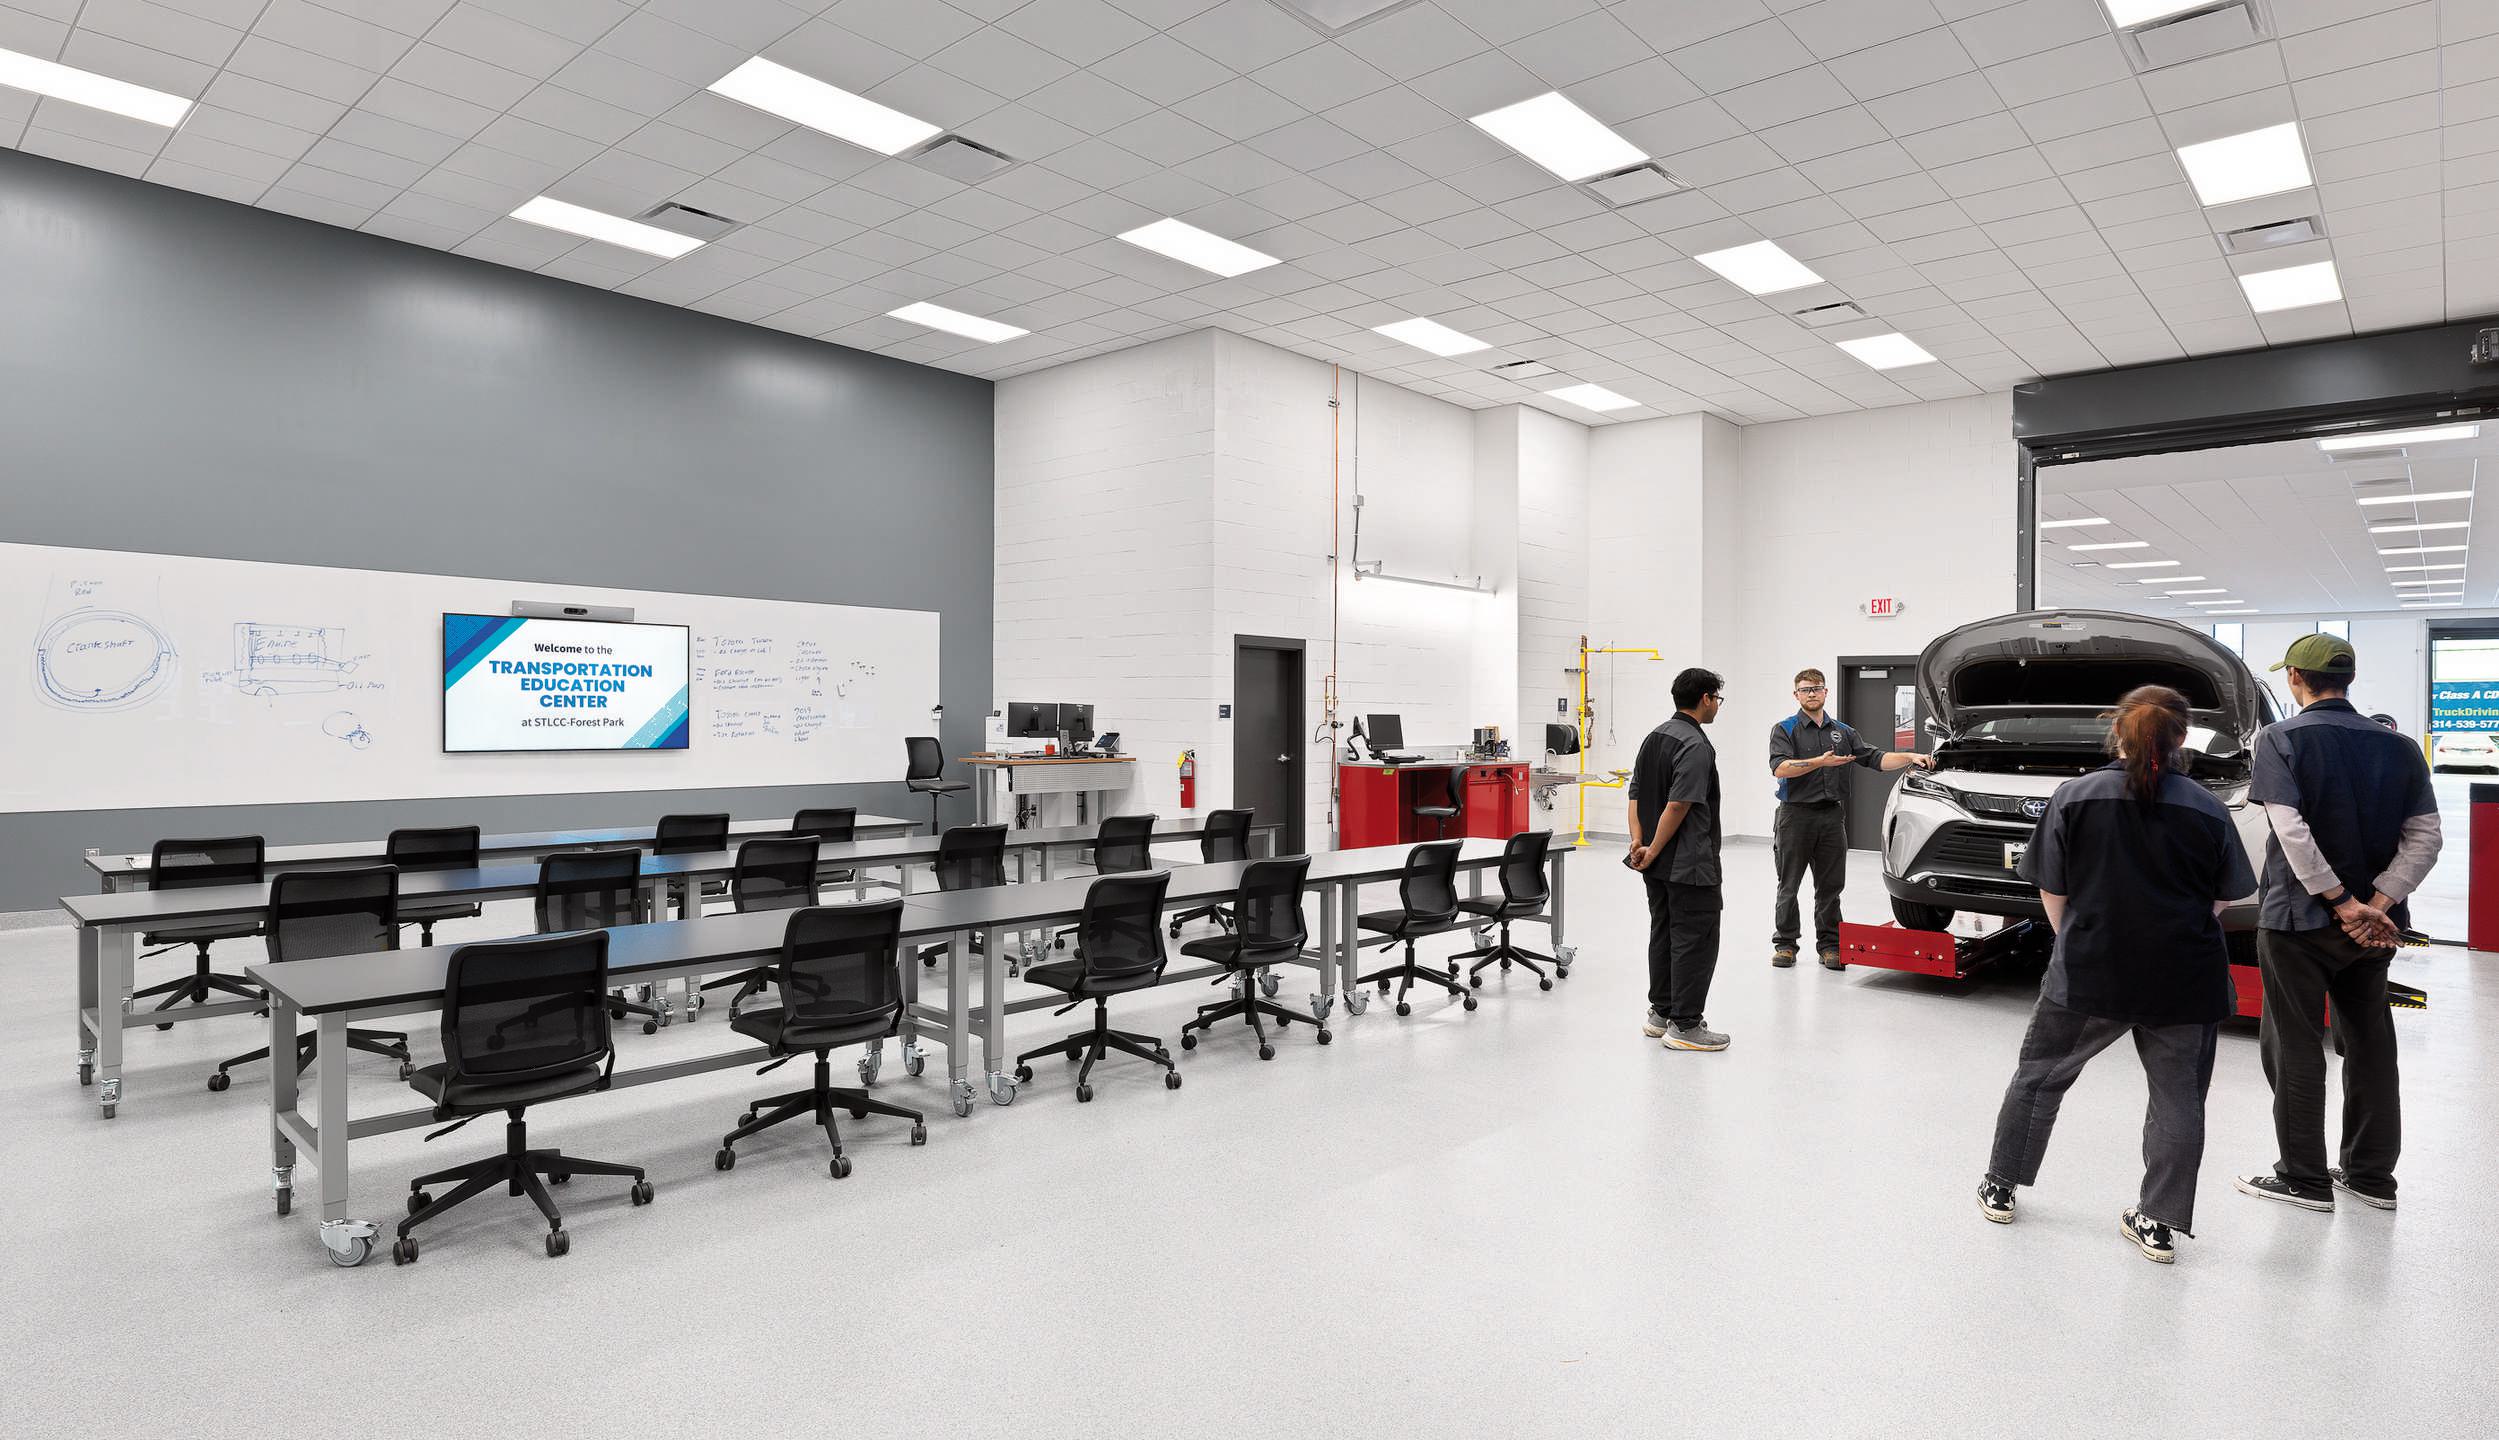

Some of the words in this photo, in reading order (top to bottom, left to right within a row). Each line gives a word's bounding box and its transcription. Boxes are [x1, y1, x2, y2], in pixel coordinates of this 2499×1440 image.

[1871, 598, 1892, 614] EXIT
[534, 643, 582, 654] Welcome
[585, 646, 594, 654] to
[597, 645, 612, 655] the
[489, 660, 653, 677] TRANSPORTATION
[521, 678, 625, 693] EDUCATION
[2439, 691, 2470, 700] Class
[2471, 690, 2481, 699] A
[539, 695, 608, 708] CENTER
[2432, 707, 2499, 717] TruckDrivin
[521, 719, 532, 727] at
[534, 717, 600, 728] STLCC-Forest
[603, 717, 624, 728] Park
[2432, 720, 2499, 729] 314-539-577
